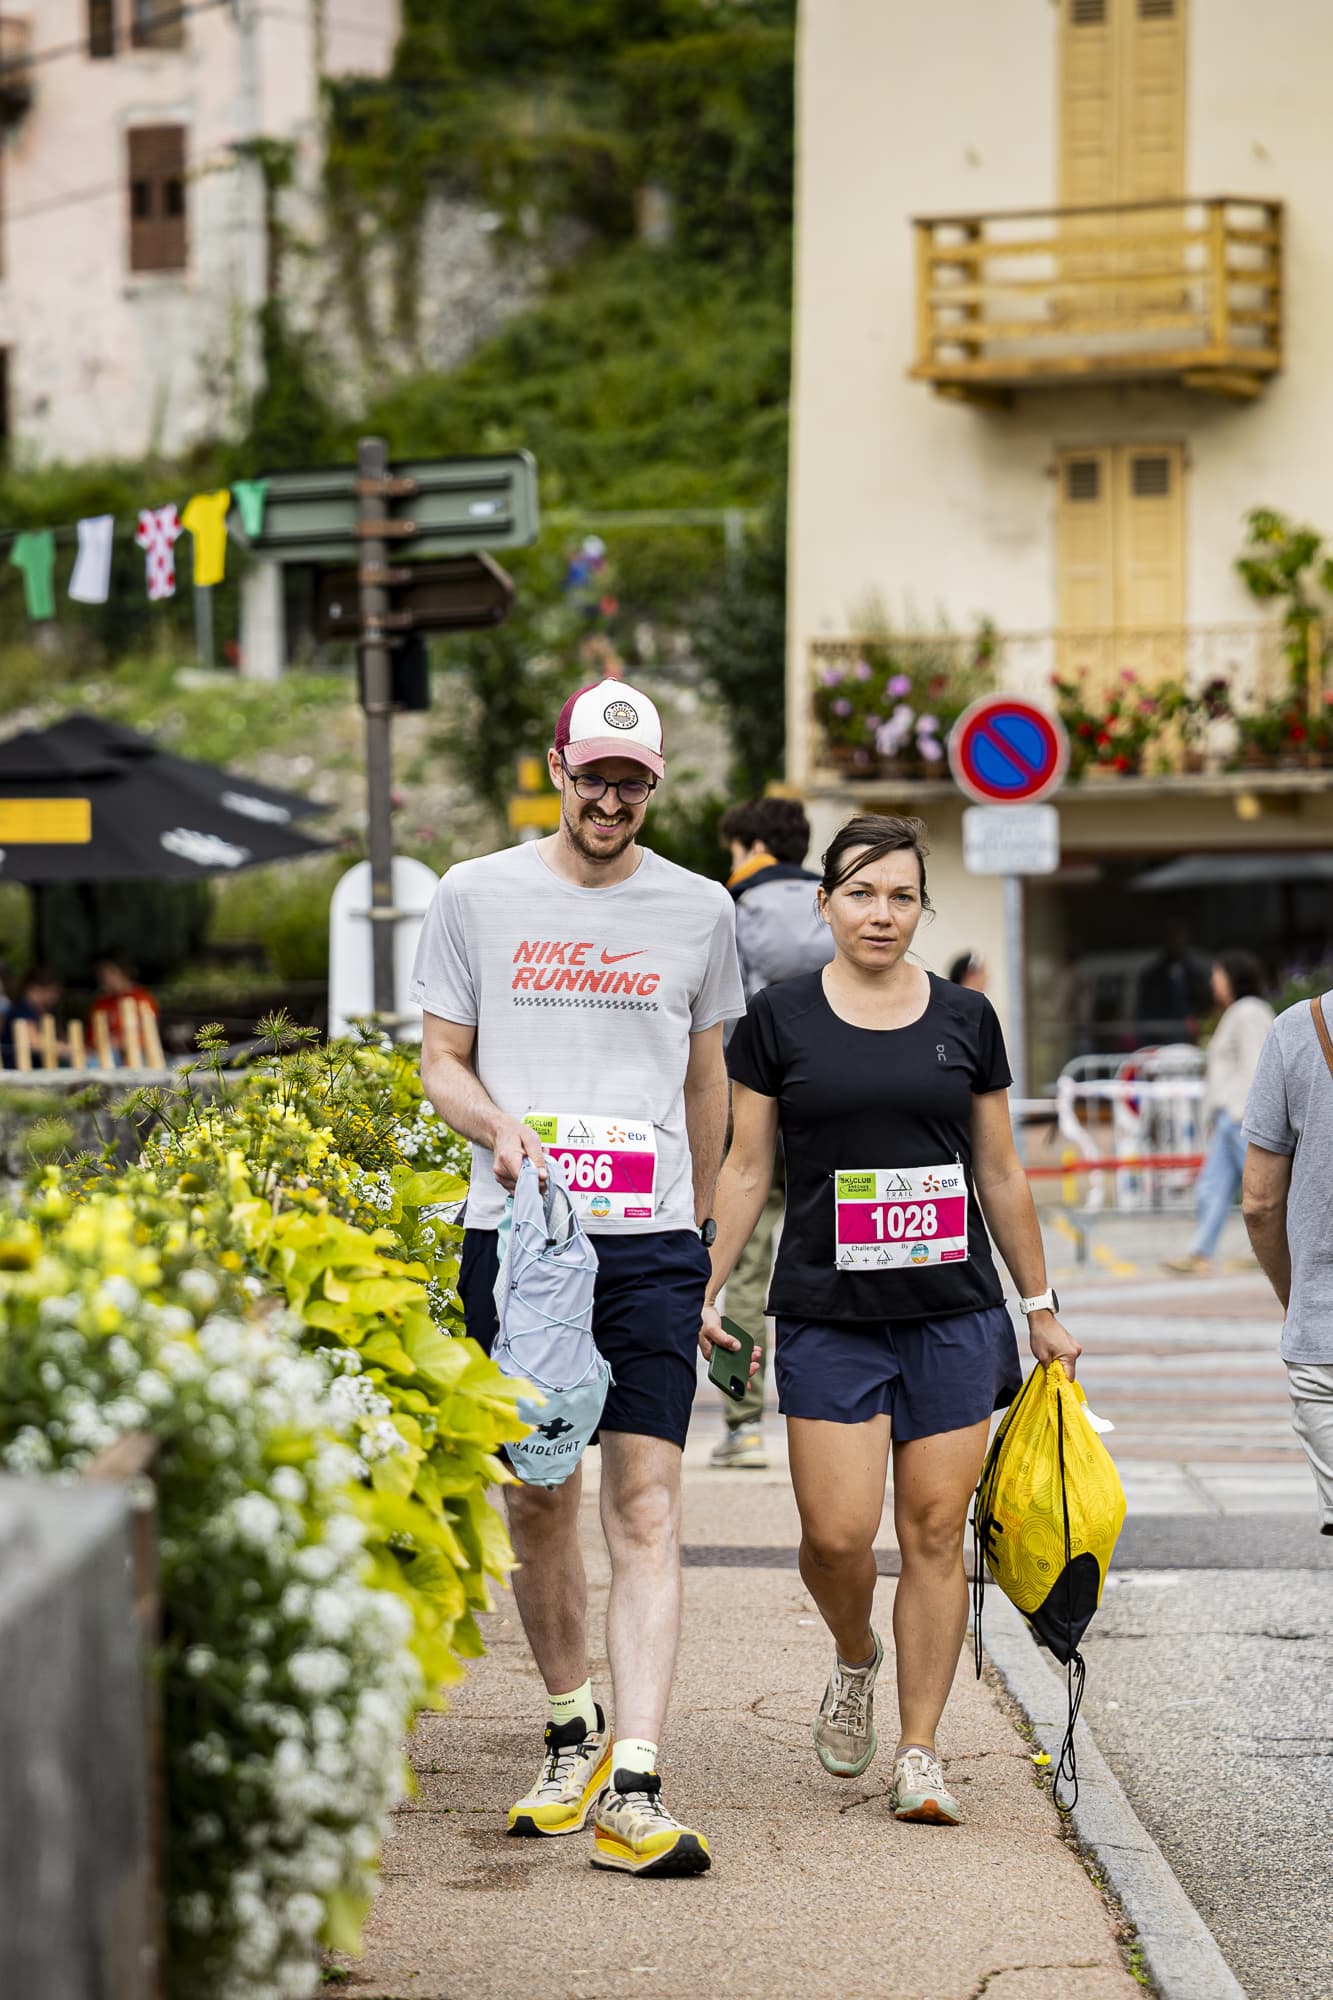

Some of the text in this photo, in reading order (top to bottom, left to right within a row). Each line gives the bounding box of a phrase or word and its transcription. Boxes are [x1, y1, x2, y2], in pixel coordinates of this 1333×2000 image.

[512, 940, 594, 966] NIKE
[511, 966, 660, 996] RUNNING
[559, 1152, 613, 1189] 966
[871, 1203, 938, 1240] 1028
[851, 1244, 881, 1252] Challenge
